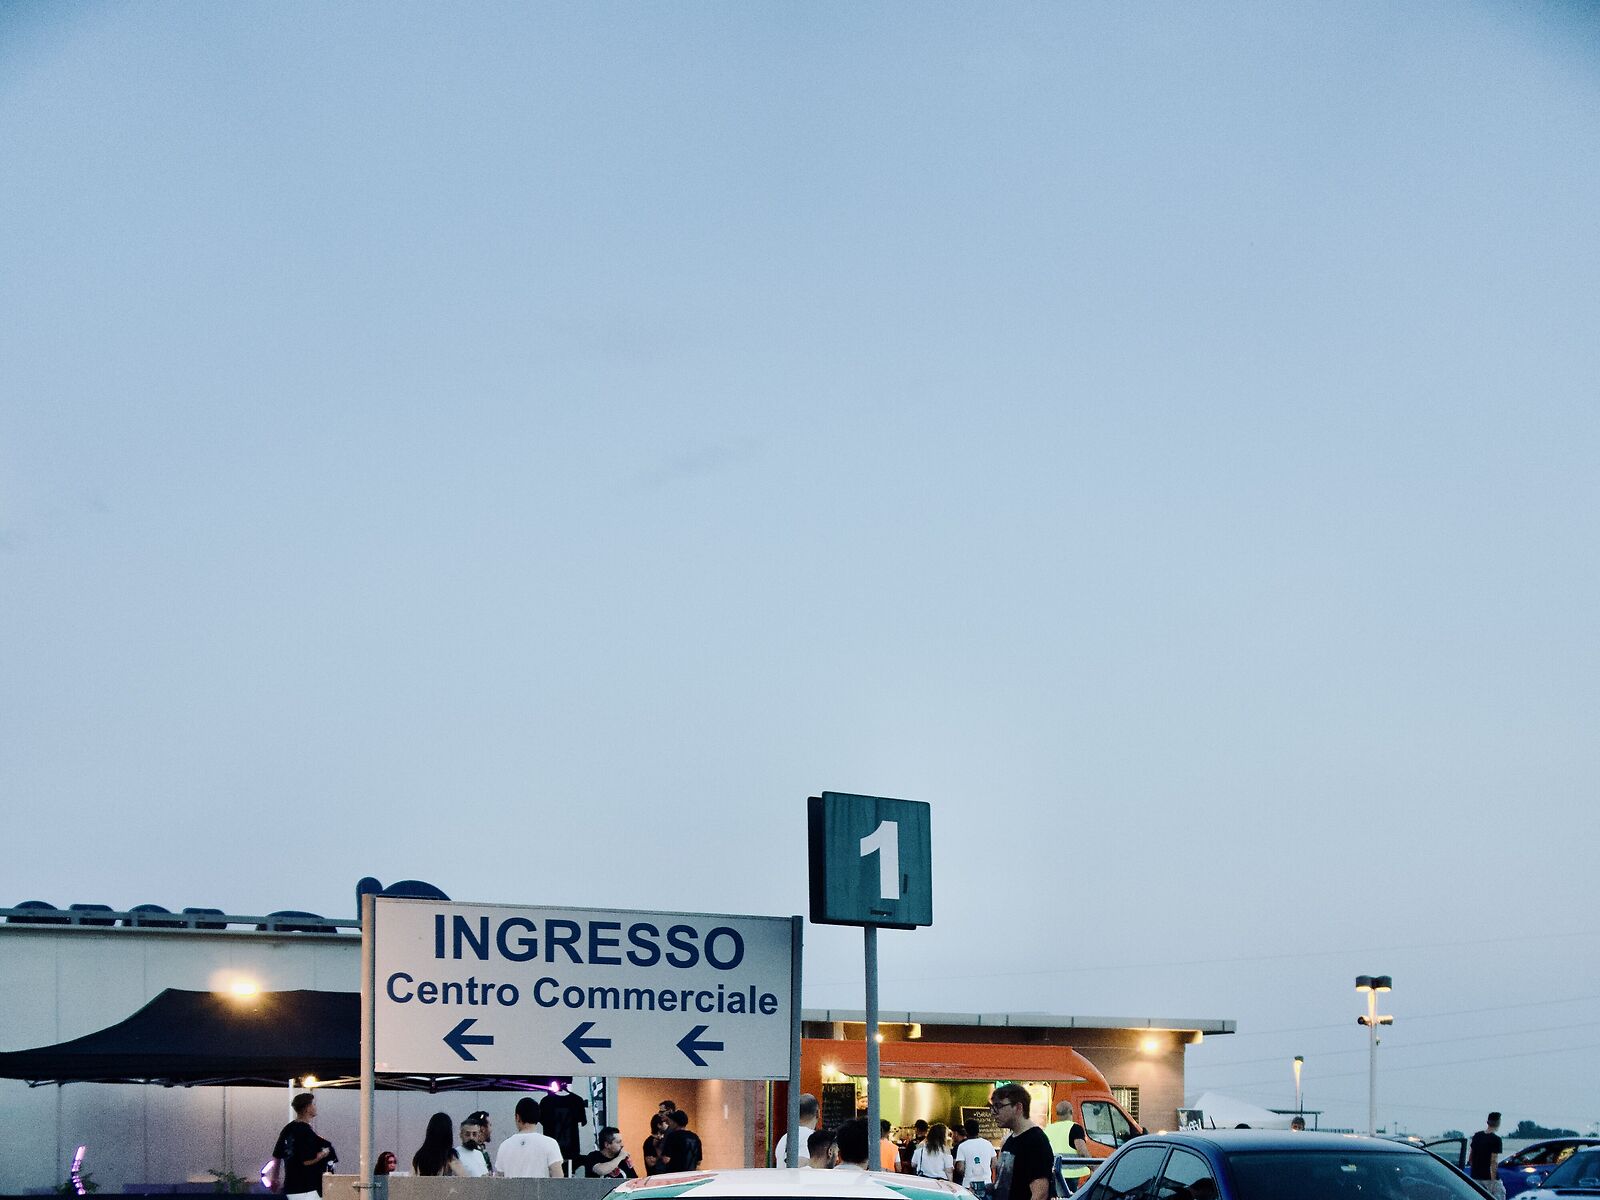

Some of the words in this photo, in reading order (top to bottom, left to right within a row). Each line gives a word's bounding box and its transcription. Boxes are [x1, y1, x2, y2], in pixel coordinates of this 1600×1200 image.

[860, 820, 900, 900] 1
[434, 914, 745, 970] INGRESSO
[386, 972, 520, 1007] Centro
[533, 977, 778, 1015] Commerciale
